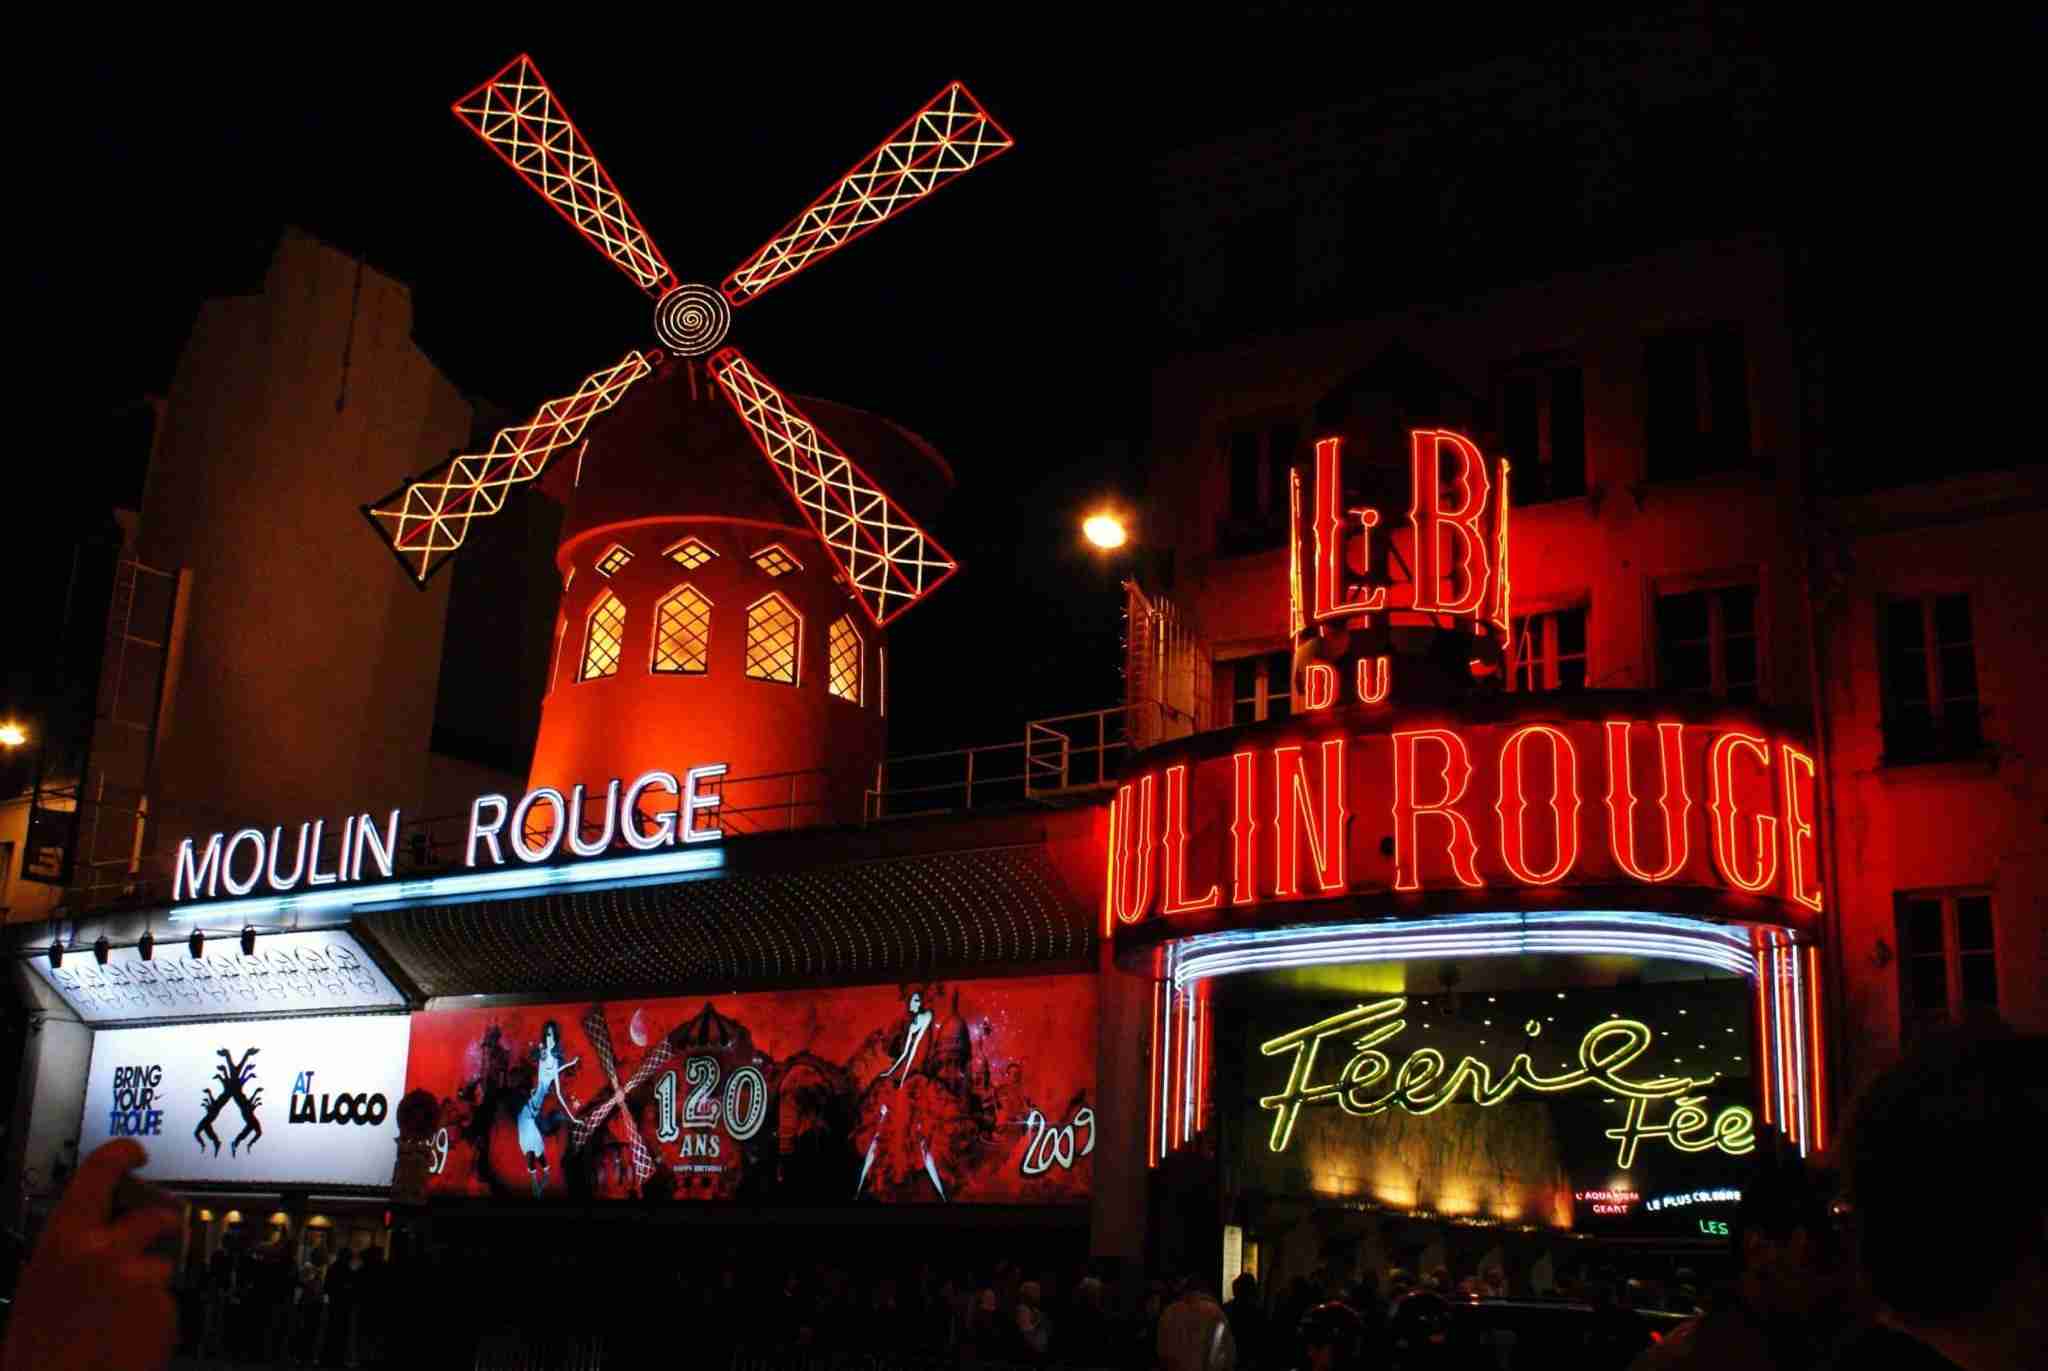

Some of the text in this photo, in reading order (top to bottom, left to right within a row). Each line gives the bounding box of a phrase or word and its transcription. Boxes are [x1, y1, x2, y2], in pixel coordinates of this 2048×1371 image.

[1305, 656, 1389, 710] DU
[171, 763, 728, 901] MOULIN ROUGE
[1391, 721, 1823, 912] ROUGE
[112, 1064, 163, 1089] BRING
[293, 1070, 315, 1094] AT
[112, 1087, 154, 1111] YOUR
[288, 1092, 388, 1126] LA LOCO
[654, 1056, 768, 1142] 120
[679, 1133, 721, 1158] ANS
[1023, 1107, 1096, 1175] 2009
[1699, 1218, 1730, 1236] LES
